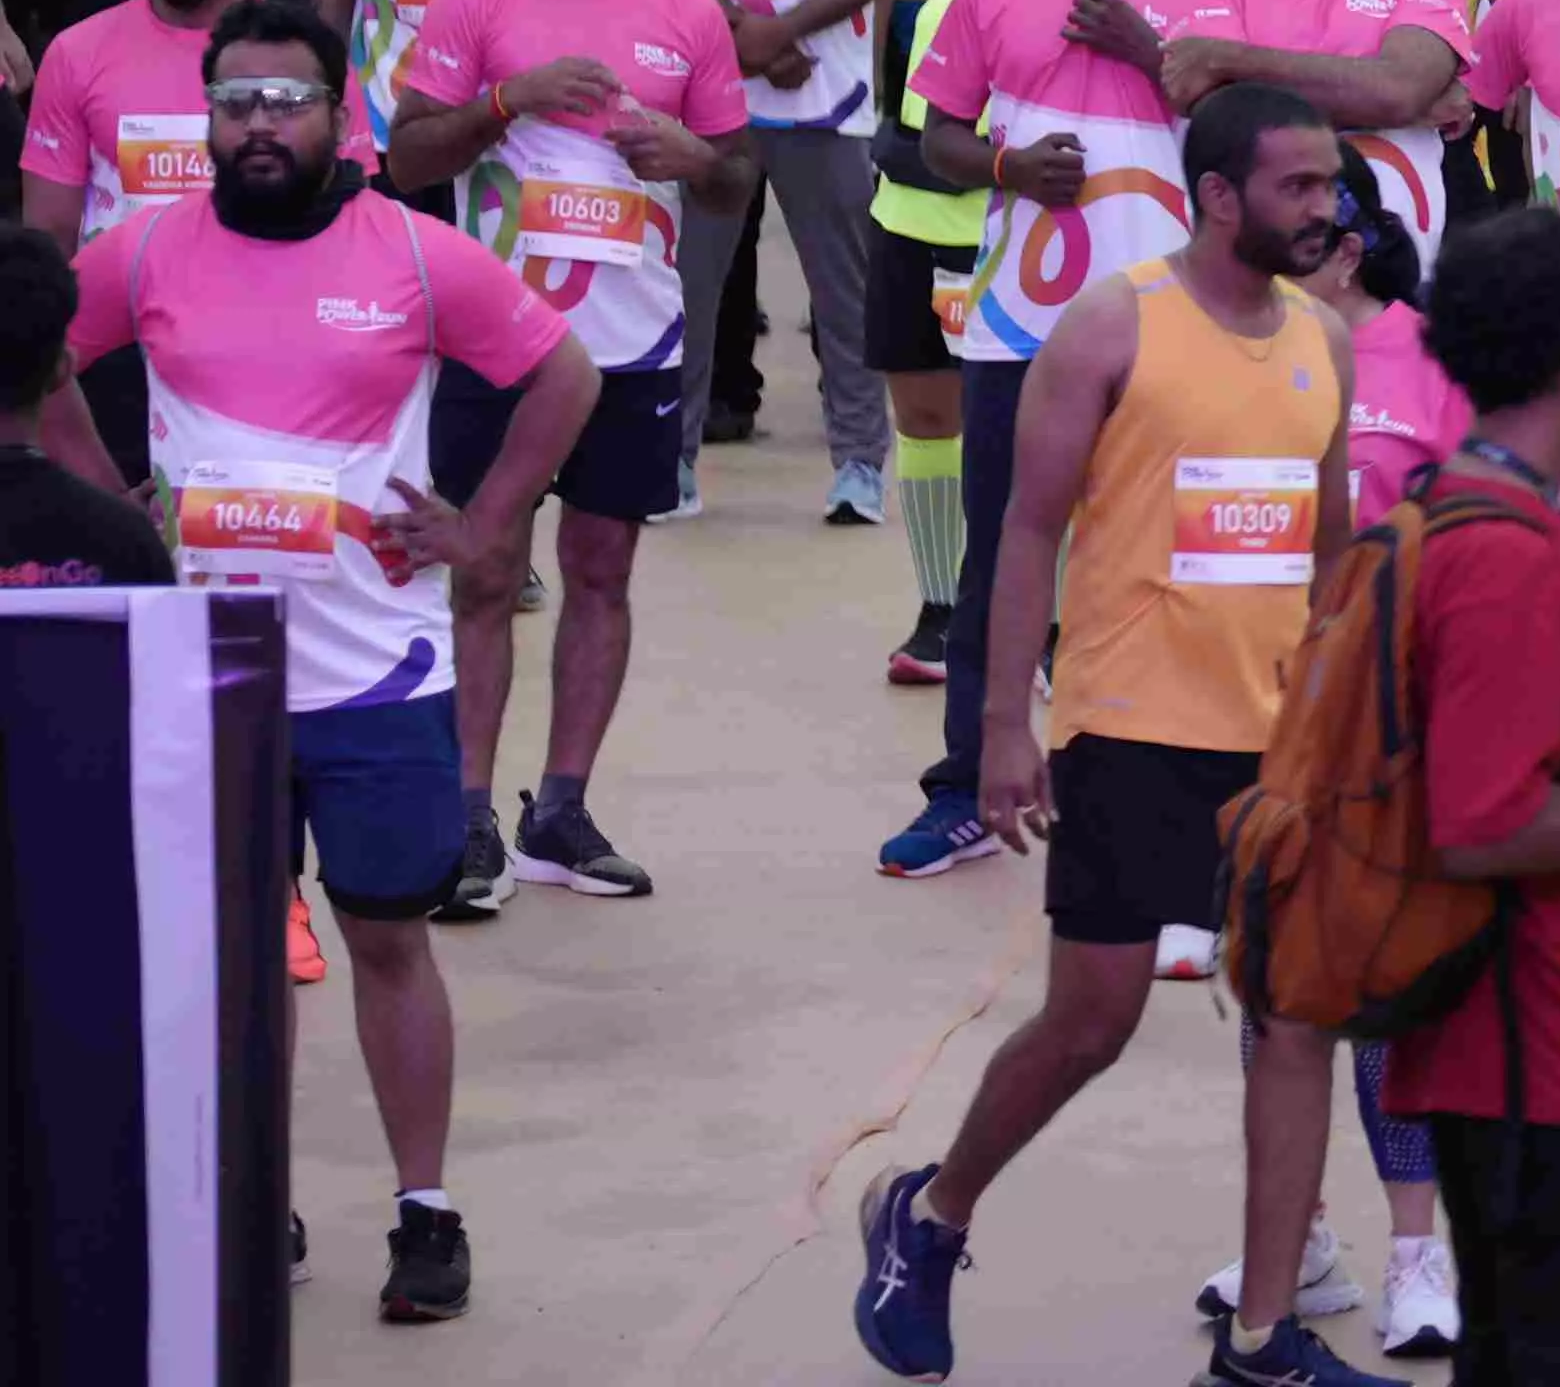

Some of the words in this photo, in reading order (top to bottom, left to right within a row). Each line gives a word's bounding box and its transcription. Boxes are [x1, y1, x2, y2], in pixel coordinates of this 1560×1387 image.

[549, 193, 621, 223] 10603
[214, 502, 303, 532] 10464
[1208, 502, 1292, 534] 10309
